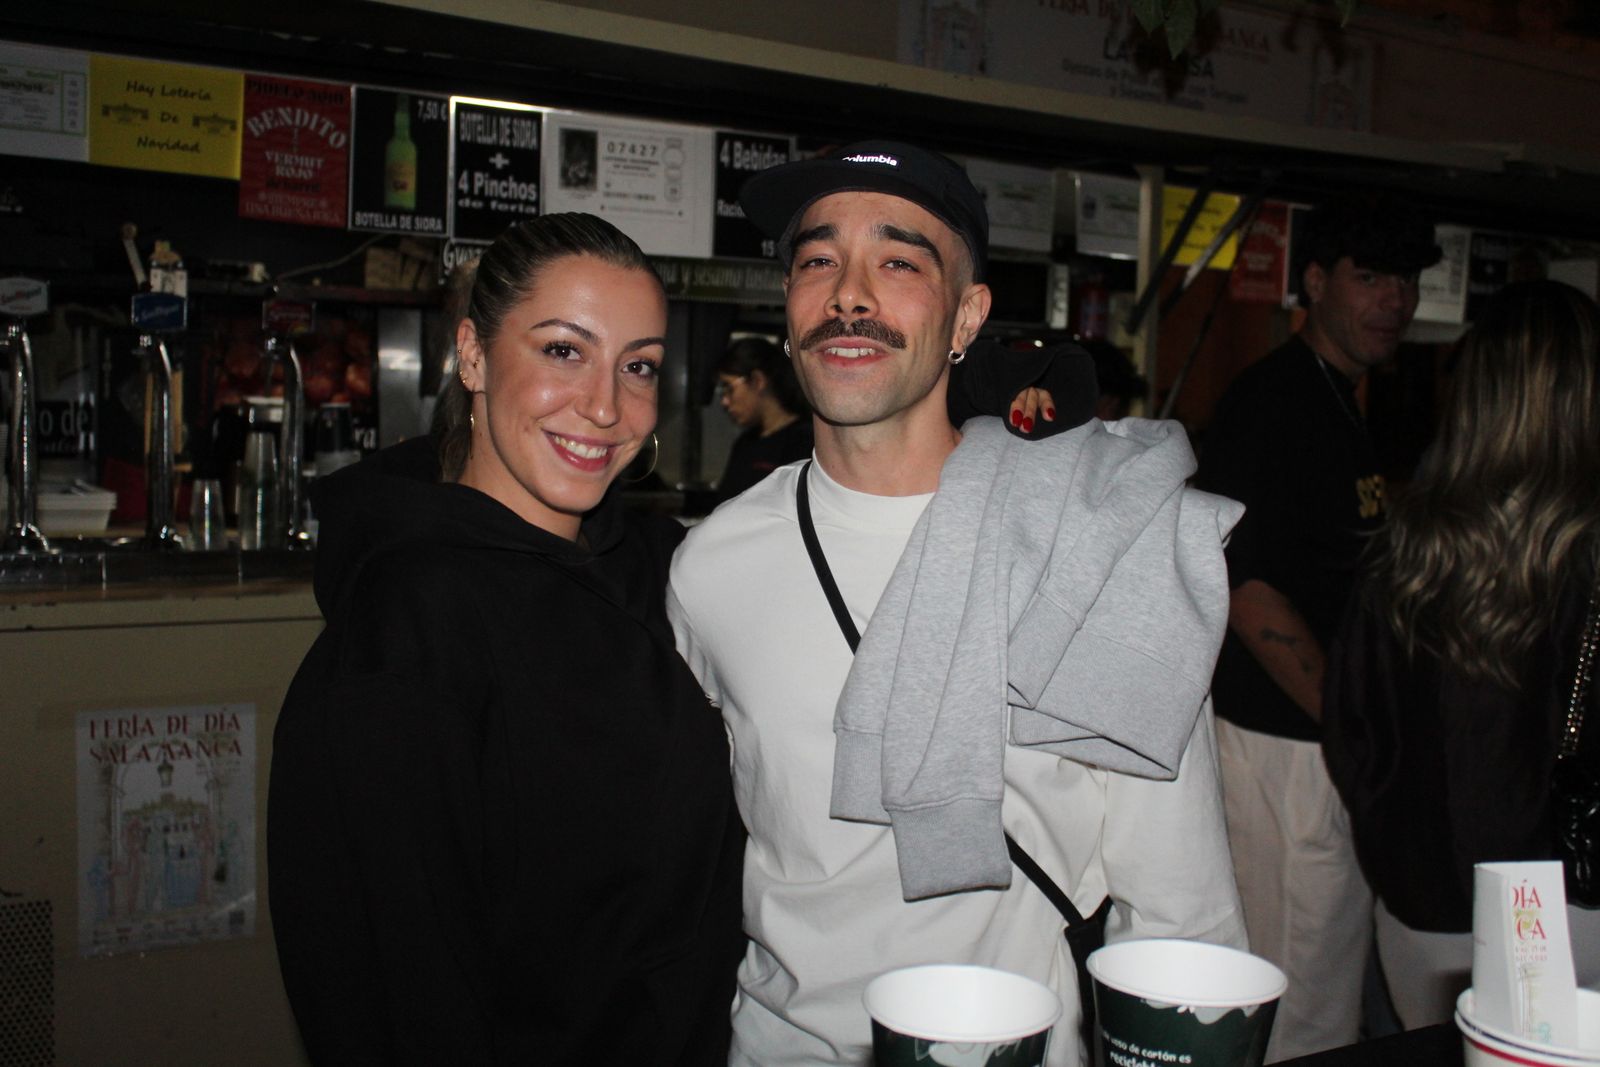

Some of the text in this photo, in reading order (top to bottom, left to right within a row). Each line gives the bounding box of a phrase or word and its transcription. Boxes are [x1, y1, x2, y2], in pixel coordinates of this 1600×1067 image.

[126, 81, 154, 97] Hay
[161, 112, 179, 123] De
[417, 99, 440, 122] 7,50
[246, 106, 346, 149] BENDITO
[459, 111, 538, 149] BOTELLA DE SIDRA
[137, 136, 200, 153] Navidad
[265, 150, 324, 169] VERMUT
[720, 140, 787, 170] 4 Bebidas
[275, 165, 313, 180] ROJO
[458, 170, 537, 202] 4 Pinchos
[354, 211, 443, 231] BOTELLA DE SIDRA
[761, 240, 776, 258] 15
[89, 739, 242, 764] SALAMANCA
[1129, 1043, 1140, 1055] de
[1141, 1048, 1177, 1062] cartón
[1179, 1055, 1192, 1064] es
